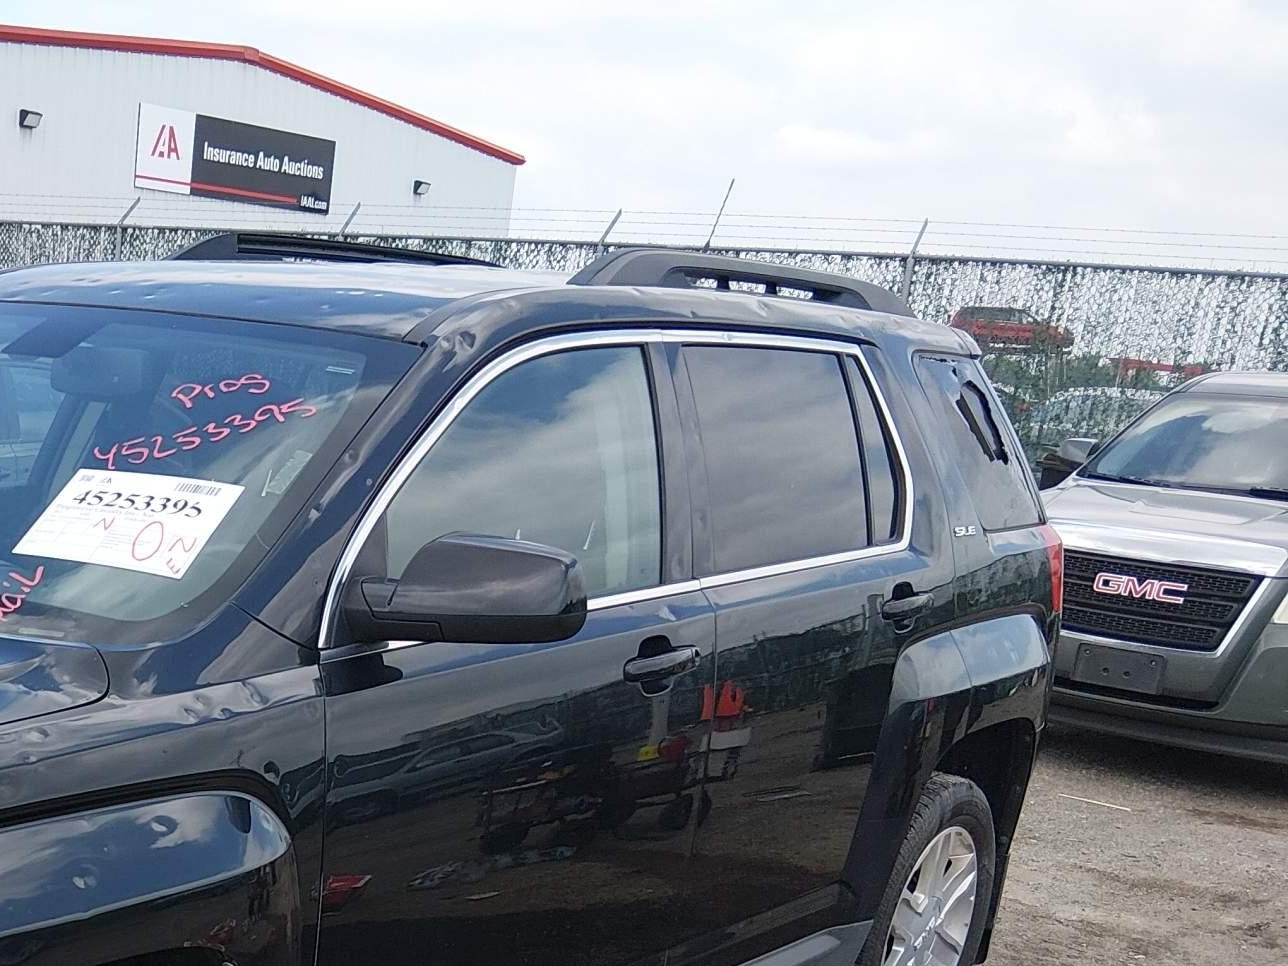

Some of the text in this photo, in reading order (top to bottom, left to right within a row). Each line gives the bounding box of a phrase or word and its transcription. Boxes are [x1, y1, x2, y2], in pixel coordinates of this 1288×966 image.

[202, 141, 325, 180] Insurance Auto Auctions
[72, 488, 203, 518] 45253395
[1093, 572, 1189, 604] GMC
